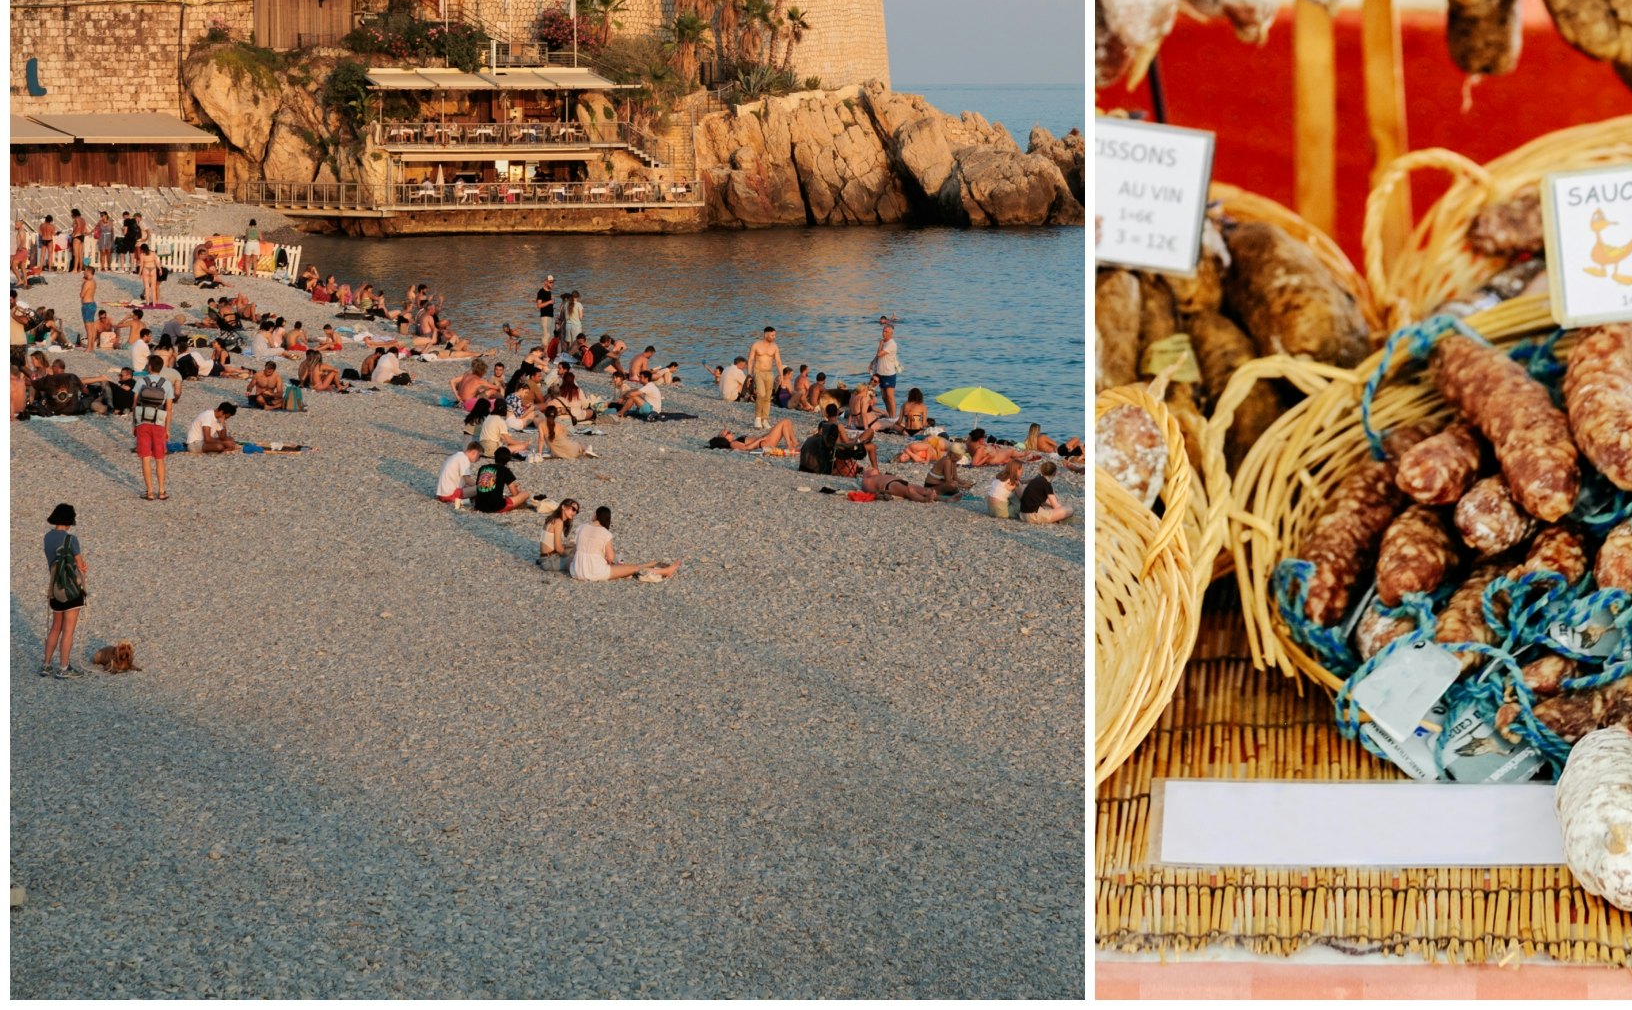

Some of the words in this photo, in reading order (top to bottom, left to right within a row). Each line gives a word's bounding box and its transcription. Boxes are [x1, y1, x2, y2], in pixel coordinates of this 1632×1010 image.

[1118, 181, 1145, 198] AU
[1151, 185, 1183, 203] VIN
[1116, 229, 1126, 244] 3
[1147, 233, 1177, 251] 12€
